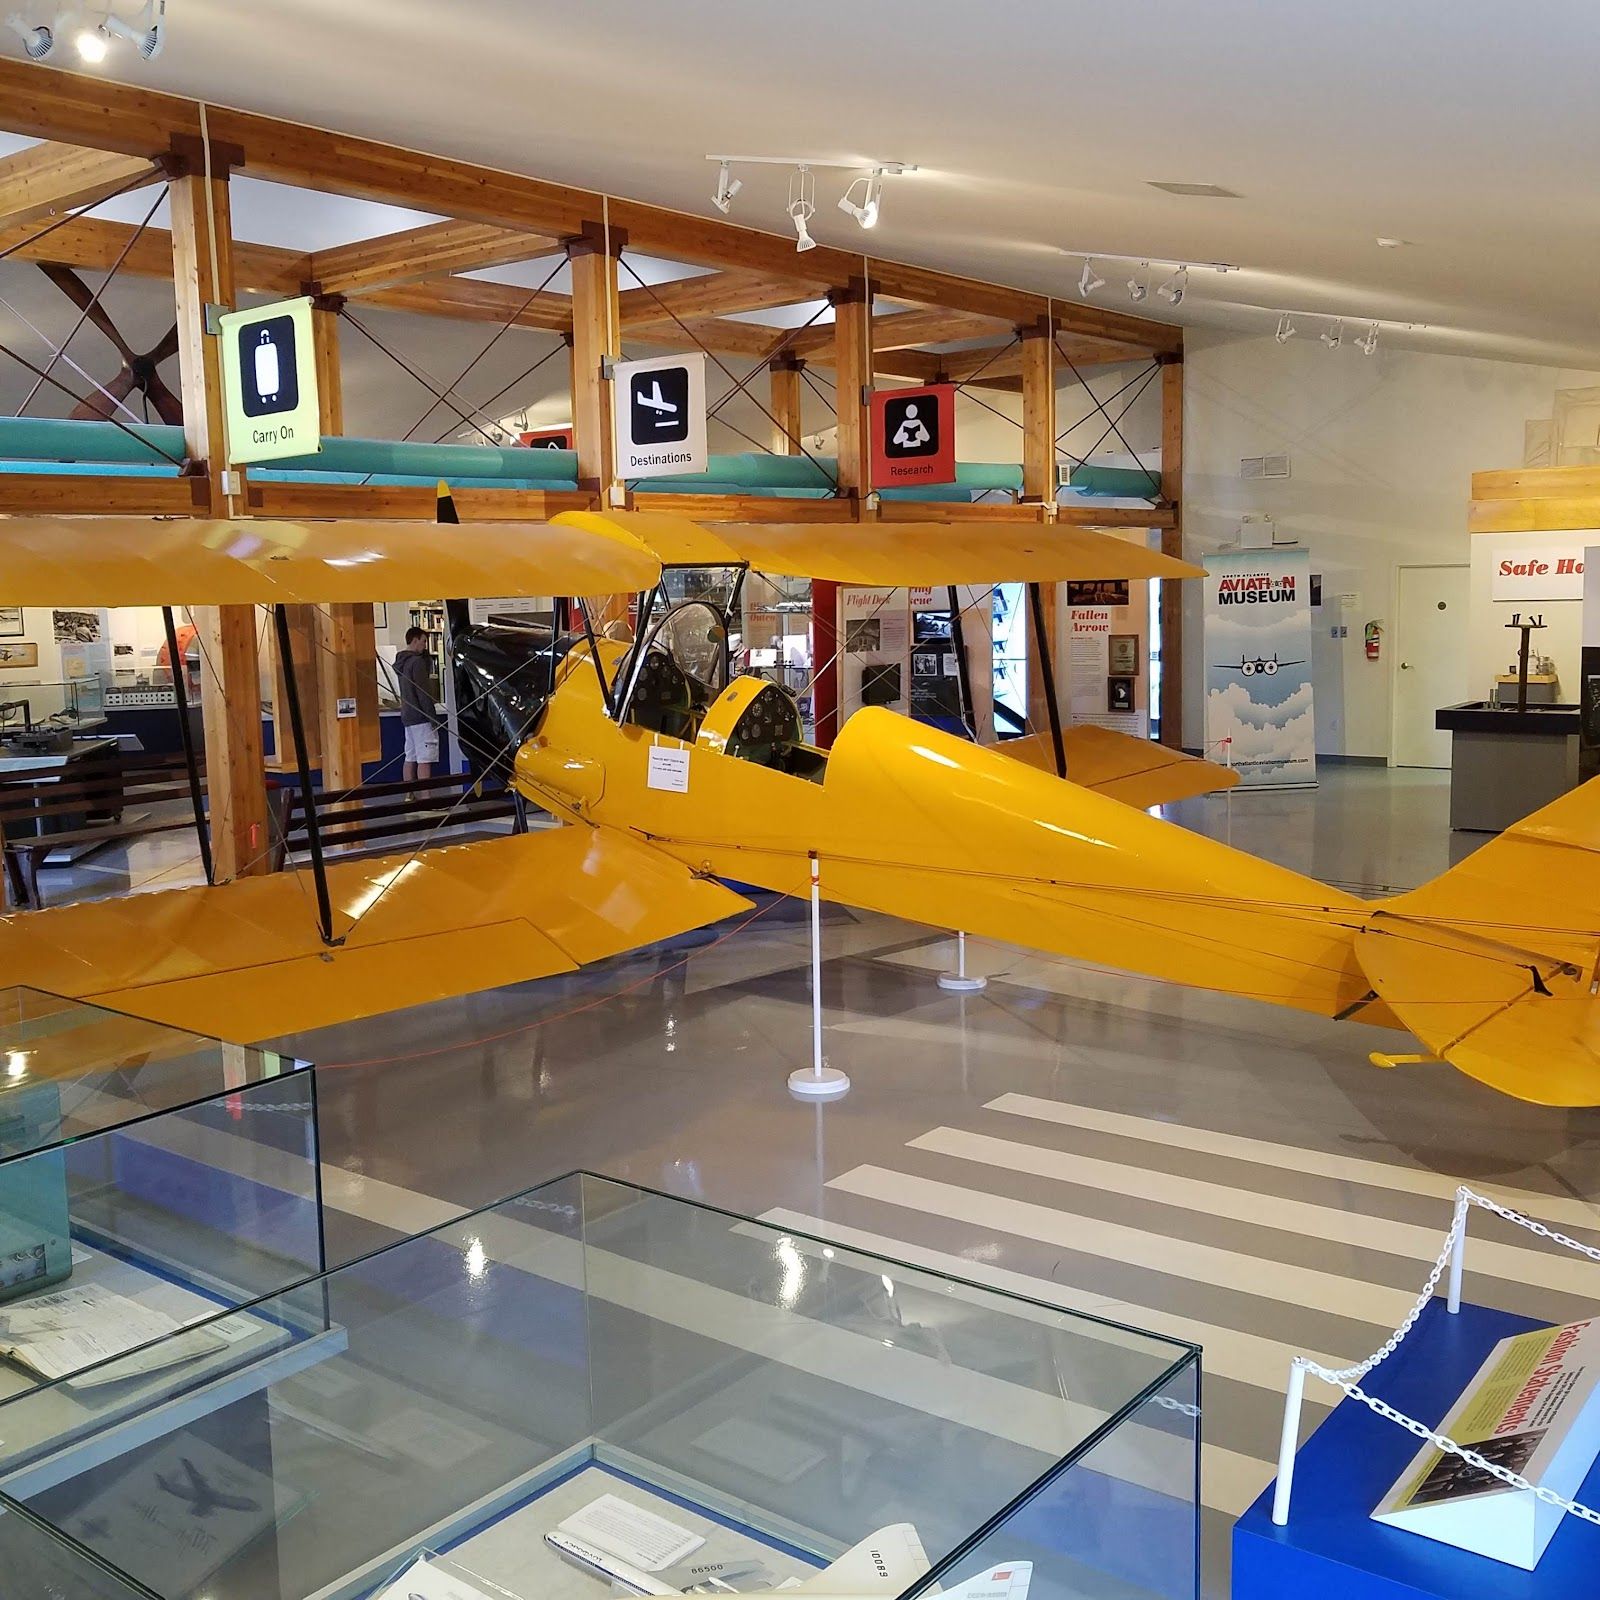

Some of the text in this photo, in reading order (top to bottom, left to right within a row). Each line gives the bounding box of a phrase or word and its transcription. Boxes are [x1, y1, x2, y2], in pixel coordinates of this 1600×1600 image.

[252, 425, 294, 445] Carry On
[630, 452, 692, 467] Destinations
[890, 464, 934, 476] Research
[1499, 558, 1585, 577] Safe Ho
[846, 593, 872, 608] Flight
[1218, 589, 1296, 605] MUSEUM
[1071, 609, 1109, 620] Fallen
[1070, 622, 1109, 633] Arrow
[1540, 1321, 1591, 1366] Fashion
[1494, 1364, 1564, 1435] Statements
